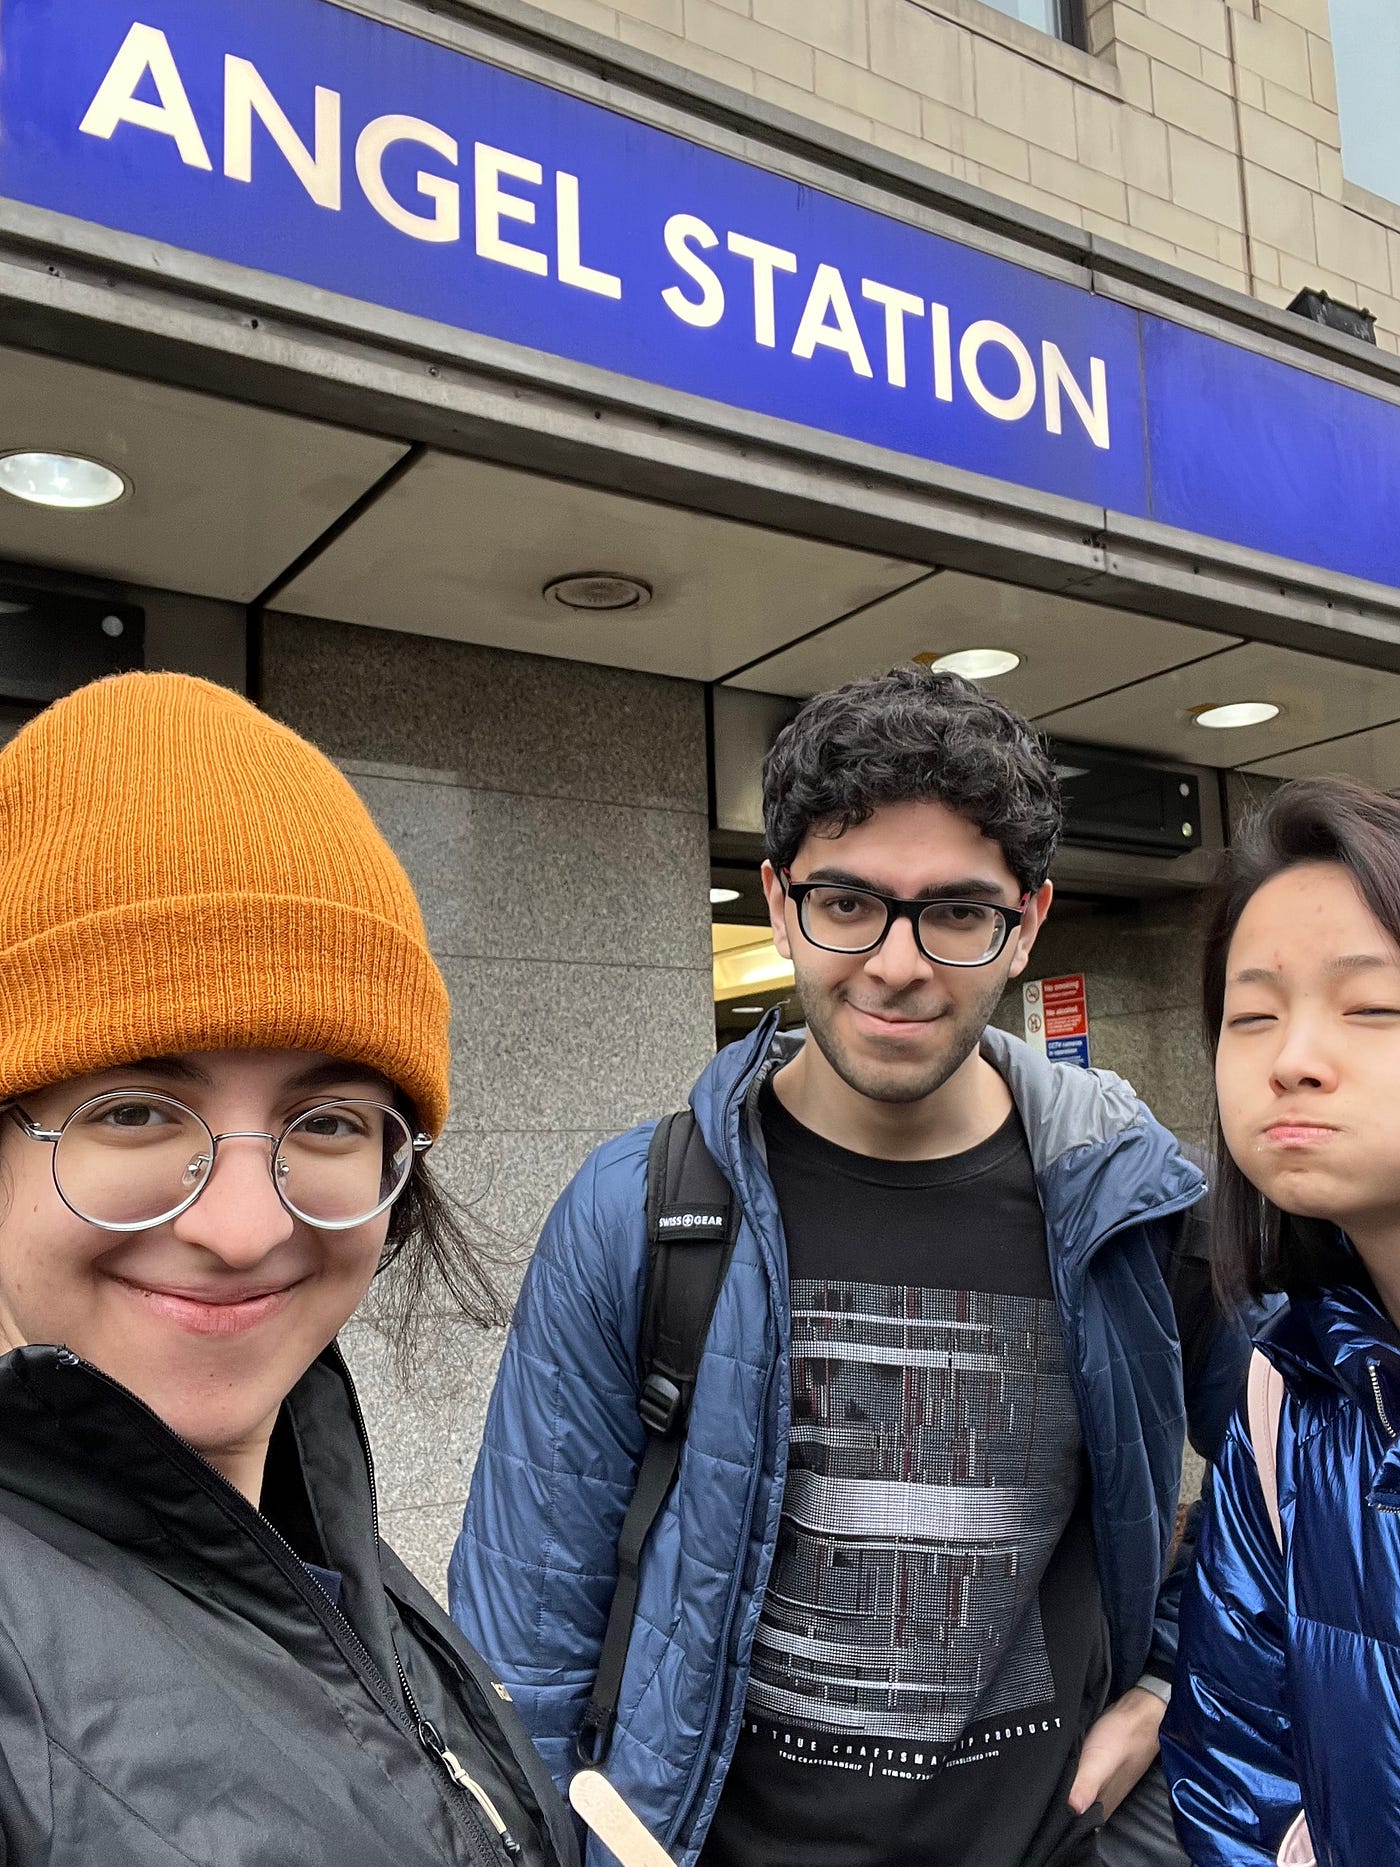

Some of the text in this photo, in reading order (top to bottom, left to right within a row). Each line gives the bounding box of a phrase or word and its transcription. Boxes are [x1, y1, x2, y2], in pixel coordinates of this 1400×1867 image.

[78, 22, 1111, 451] ANGEL STATION
[659, 1215, 723, 1228] SWISS GEAR
[772, 1730, 817, 1752] TRUE
[984, 1717, 1062, 1743] PRODUCT
[779, 1750, 863, 1772] TRUE CRAFTSMANSHIP
